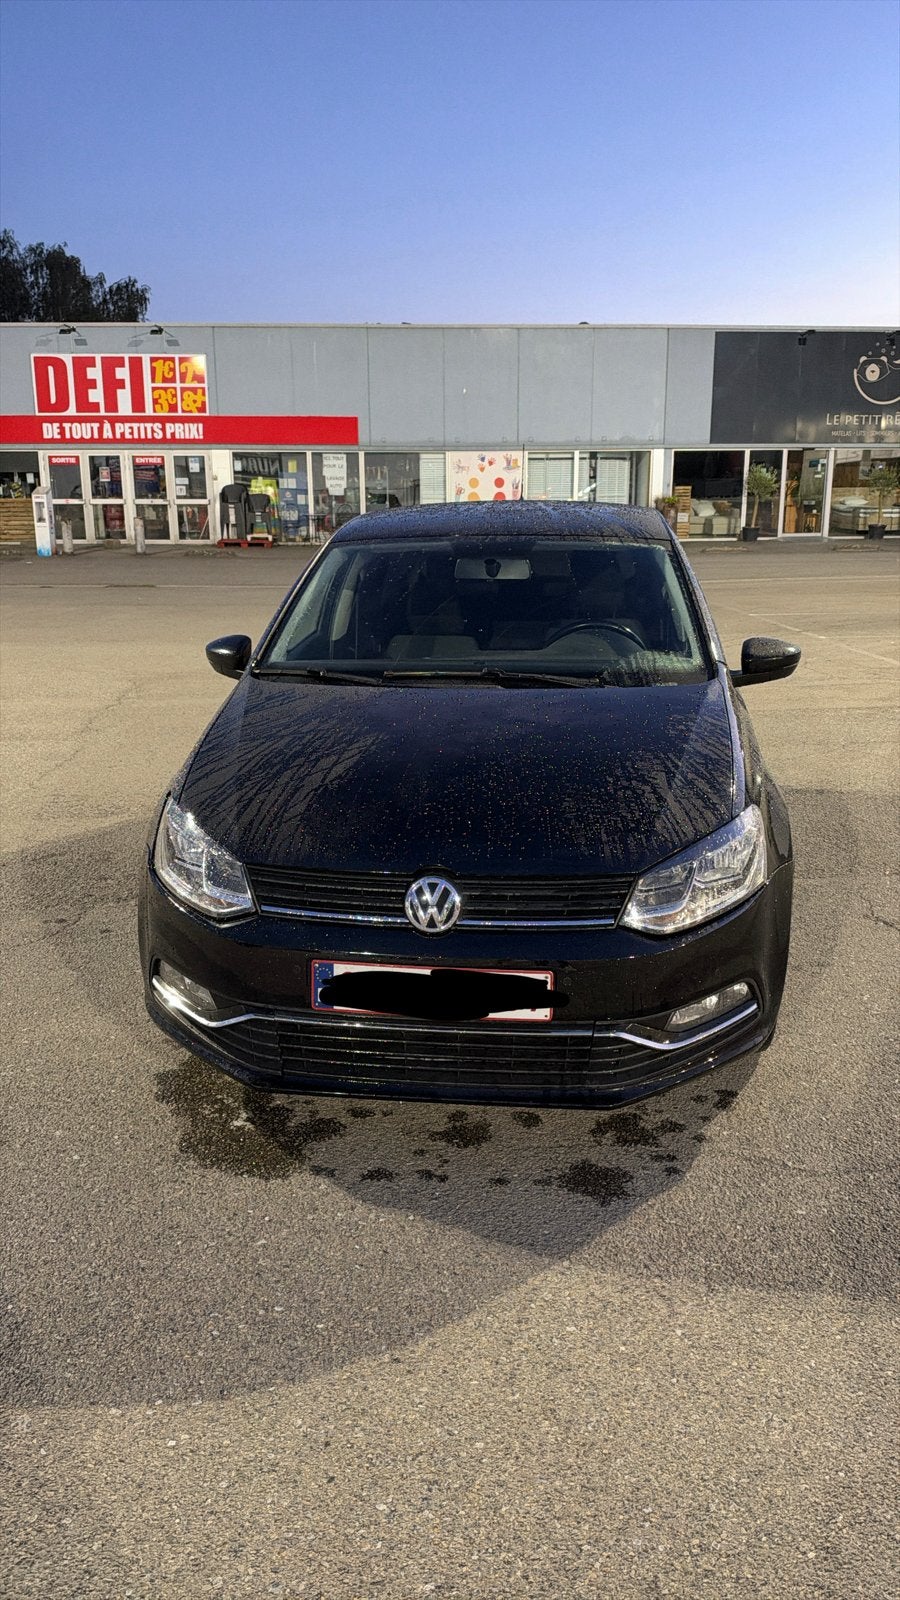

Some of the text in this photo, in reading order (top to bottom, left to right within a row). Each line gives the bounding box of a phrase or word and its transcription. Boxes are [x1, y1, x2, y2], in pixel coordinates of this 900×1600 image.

[33, 356, 146, 414] DEFI
[153, 388, 176, 413] 3€
[42, 420, 203, 439] DE TOUT À PETITS PRIX!
[826, 413, 840, 425] LE
[845, 414, 881, 425] PETIT
